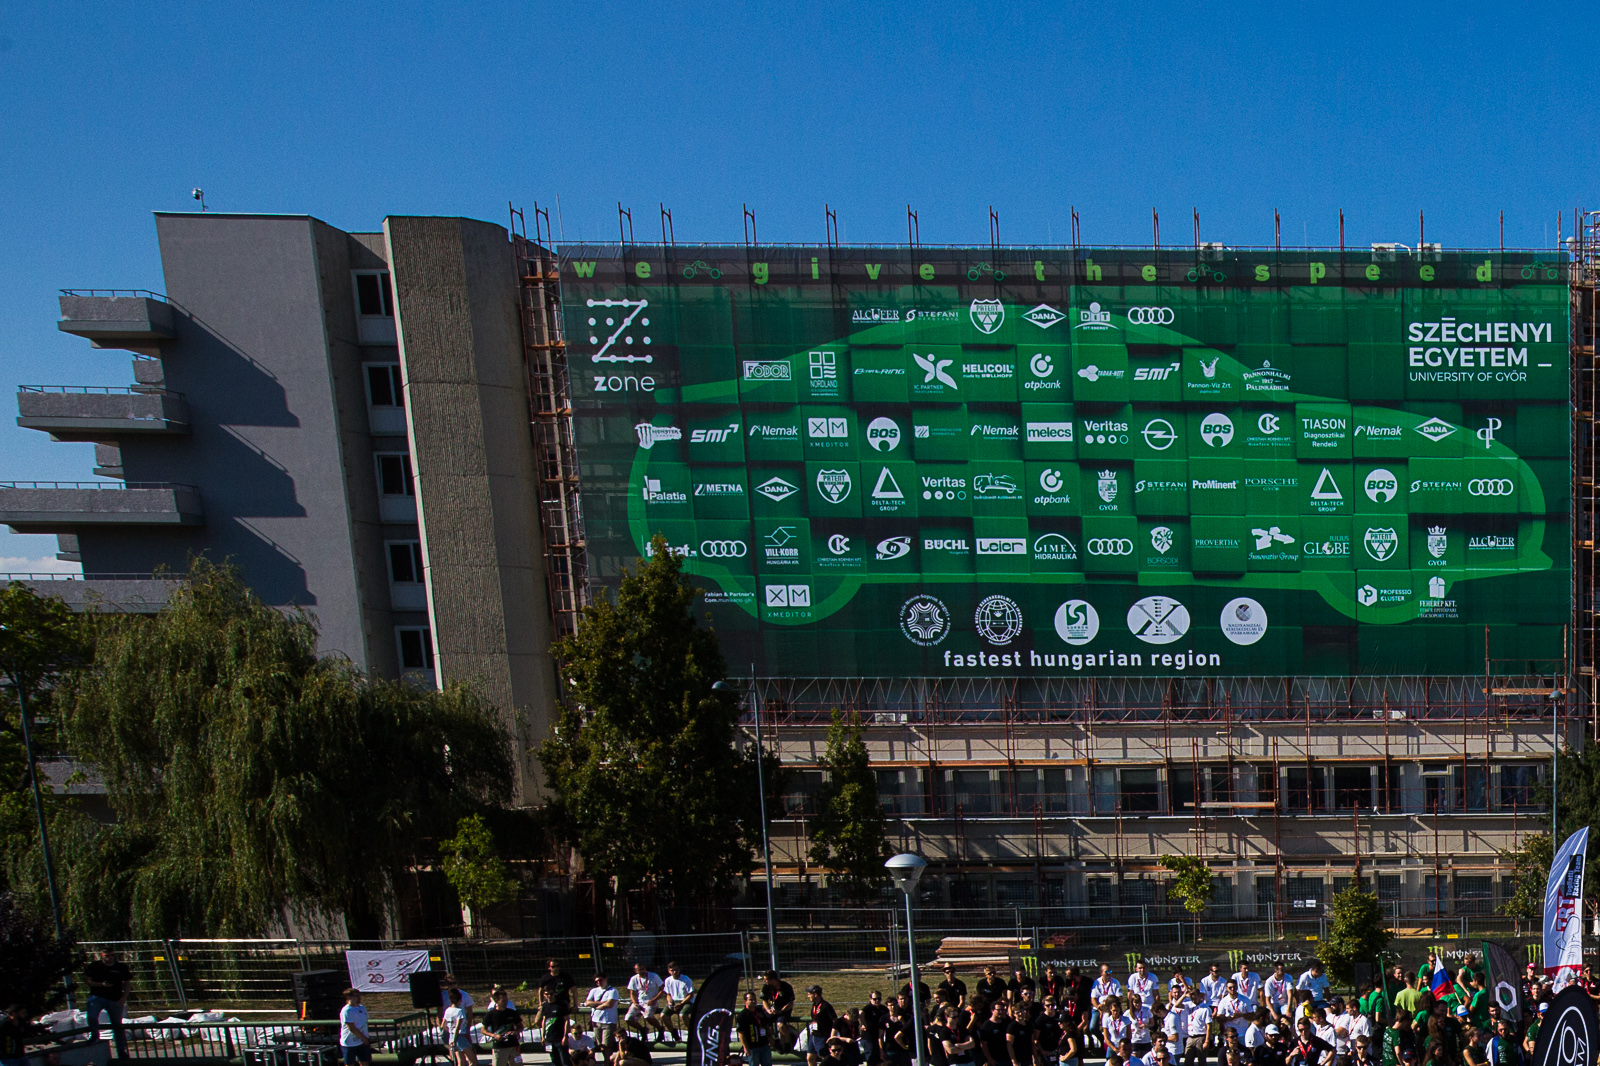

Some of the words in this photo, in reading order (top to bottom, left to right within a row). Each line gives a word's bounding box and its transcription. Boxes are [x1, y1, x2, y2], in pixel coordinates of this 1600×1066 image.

[572, 261, 651, 279] we
[752, 257, 936, 285] give
[1254, 259, 1493, 284] speed
[917, 310, 959, 318] STEFANI
[1409, 347, 1528, 367] EGYETEM
[746, 363, 789, 378] FODOR
[1409, 372, 1473, 382] UNIVERSITY
[1477, 372, 1492, 382] OF
[1495, 369, 1527, 382] GYŐR
[593, 376, 656, 392] zone
[810, 380, 838, 388] NORDLAND
[1025, 380, 1061, 391] otpbank
[1084, 420, 1128, 431] Veritas
[1202, 424, 1231, 434] BOS
[1302, 418, 1346, 430] TIASON
[762, 424, 798, 436] Nemak
[869, 428, 898, 438] BOS
[983, 424, 1019, 436] Nemak
[1028, 426, 1072, 438] melecs
[1303, 431, 1345, 440] Diagnosztikai
[1366, 425, 1402, 436] Nemak
[921, 476, 966, 488] Veritas
[1192, 480, 1237, 489] ProMinent
[1367, 480, 1395, 490] BOS
[706, 484, 743, 493] METNA
[764, 485, 789, 493] DANA
[649, 491, 687, 501] Palatia
[1034, 495, 1071, 505] otpbank
[924, 538, 970, 550] BÜCHL
[943, 650, 1022, 667] fastest
[1030, 650, 1142, 670] hungarian
[1150, 650, 1221, 670] region
